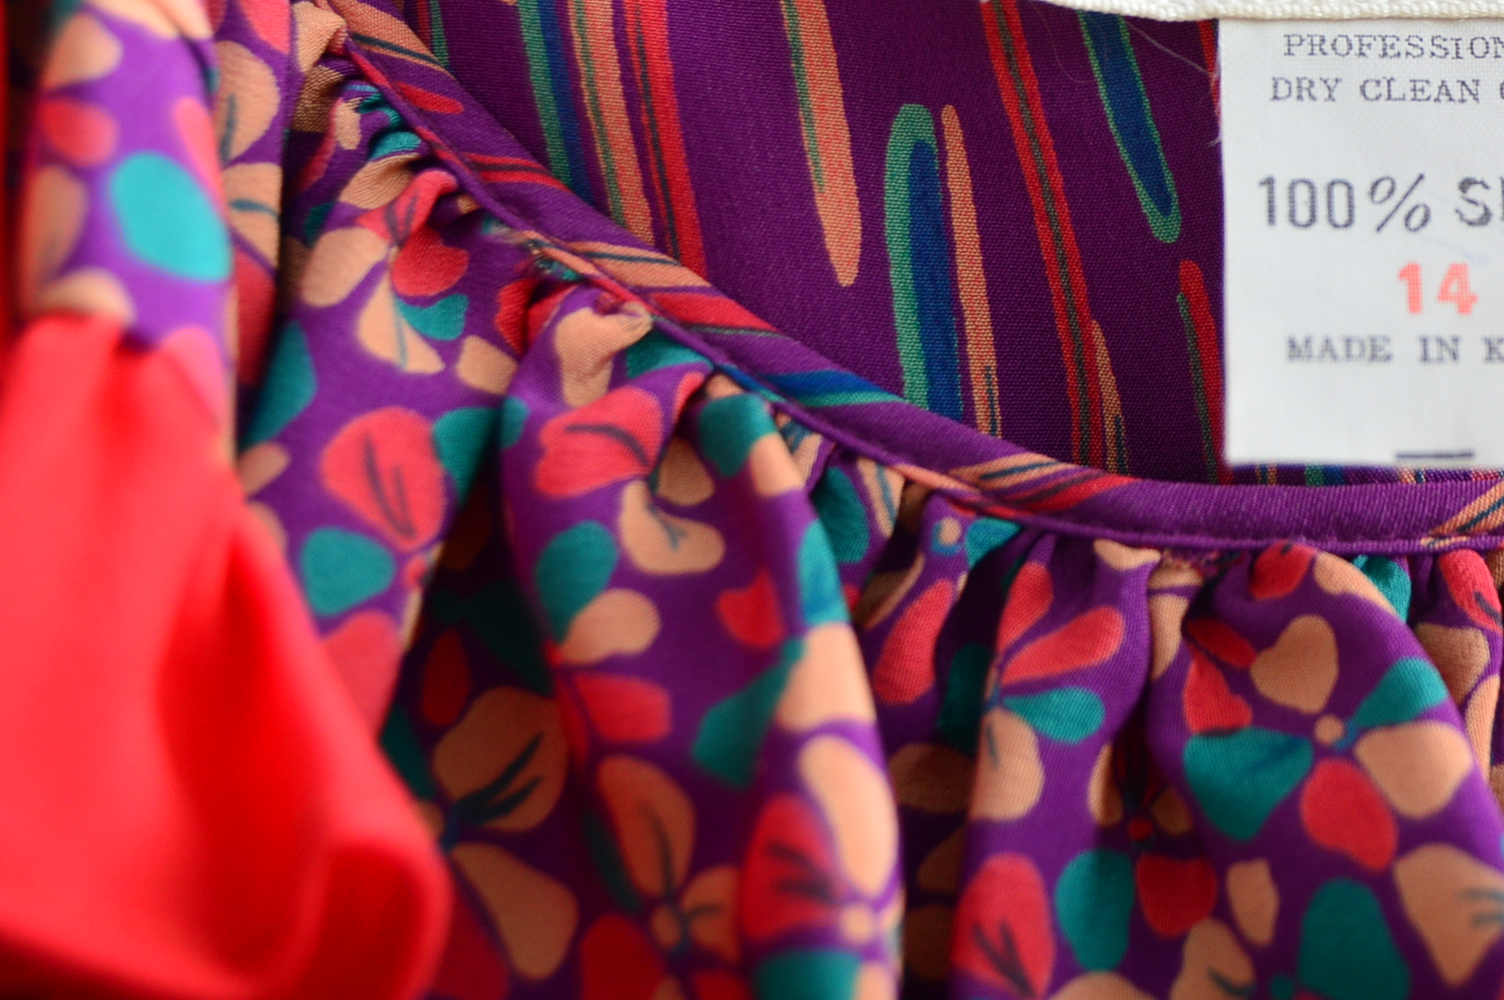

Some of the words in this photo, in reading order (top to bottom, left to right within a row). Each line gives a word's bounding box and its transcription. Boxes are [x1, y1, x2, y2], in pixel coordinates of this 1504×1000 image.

[1269, 76, 1342, 103] DRY
[1360, 77, 1480, 103] CLEAN
[1258, 173, 1432, 234] 100%
[1397, 262, 1479, 315] 14
[1285, 335, 1394, 366] MADE
[1419, 335, 1461, 365] IN
